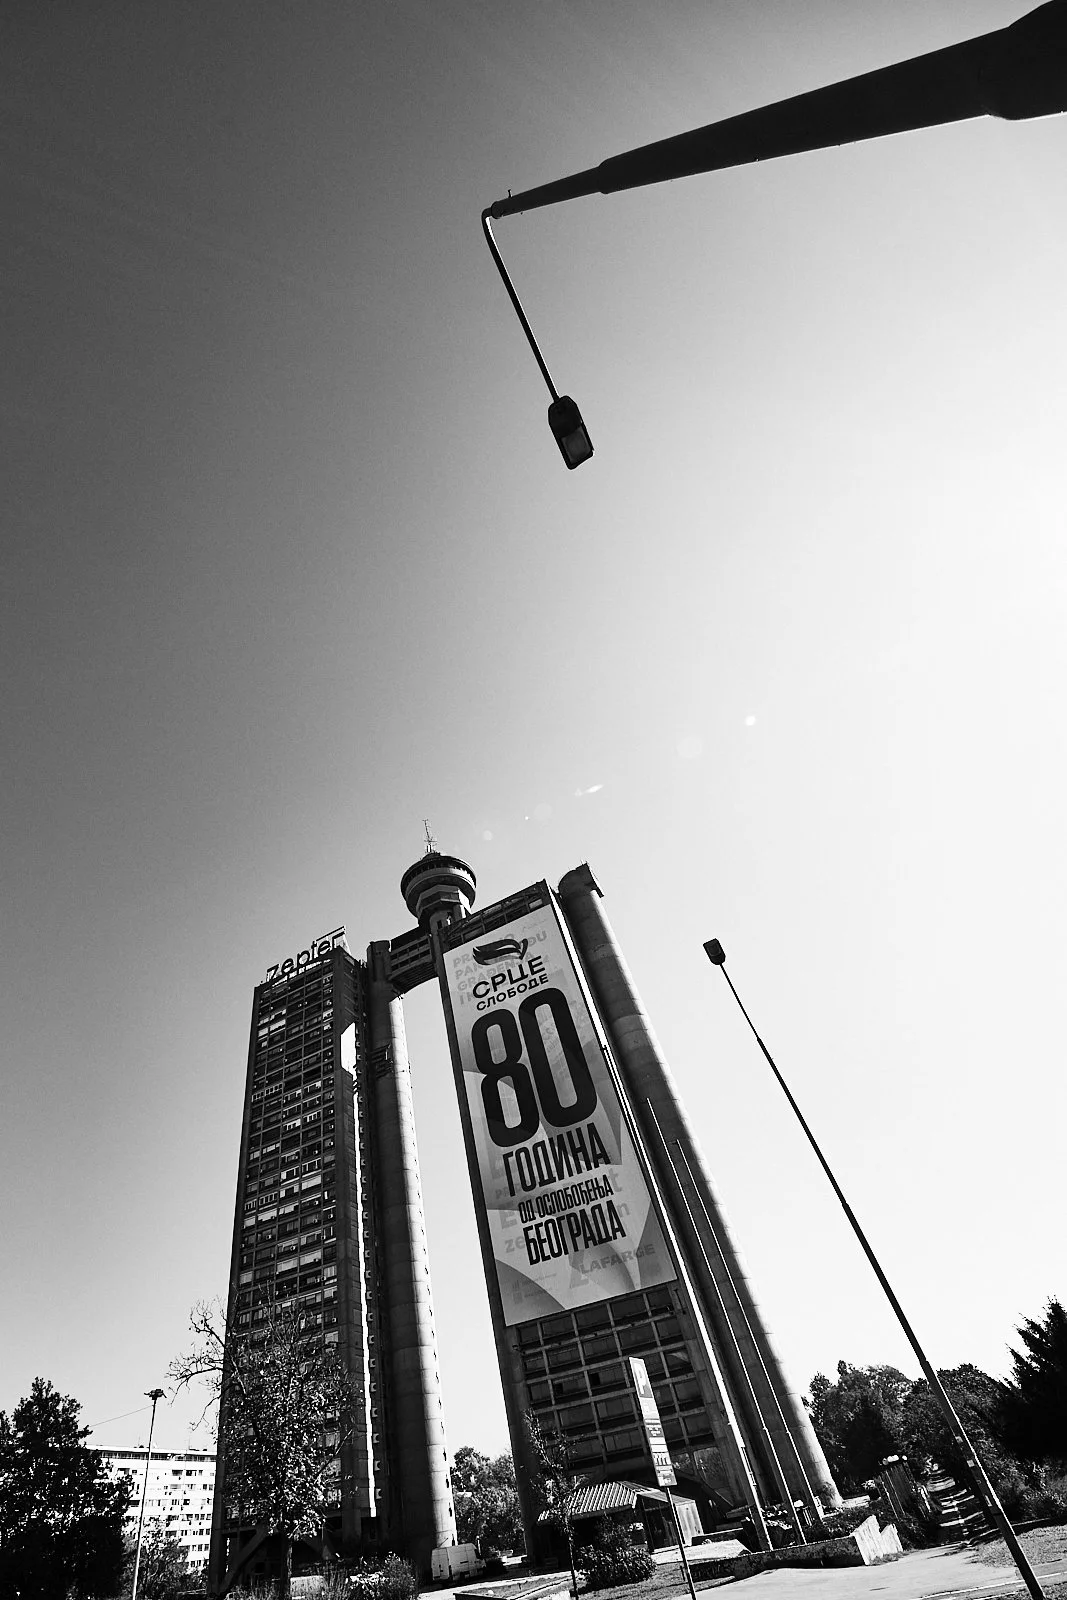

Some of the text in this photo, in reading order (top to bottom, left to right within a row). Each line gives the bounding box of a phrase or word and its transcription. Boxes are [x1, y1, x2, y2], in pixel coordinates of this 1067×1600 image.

[266, 931, 345, 980] zepter
[472, 955, 546, 999] СРЦЕ
[476, 973, 549, 1011] СЛОБОДЕ
[471, 987, 598, 1148] 80
[503, 1122, 611, 1197] ГОДИНА
[518, 1201, 537, 1224] ОД
[537, 1174, 614, 1218] ОСЛОБОЂЕЊА
[522, 1199, 627, 1266] БЕОГРАДА
[579, 1243, 656, 1275] LAFARGE
